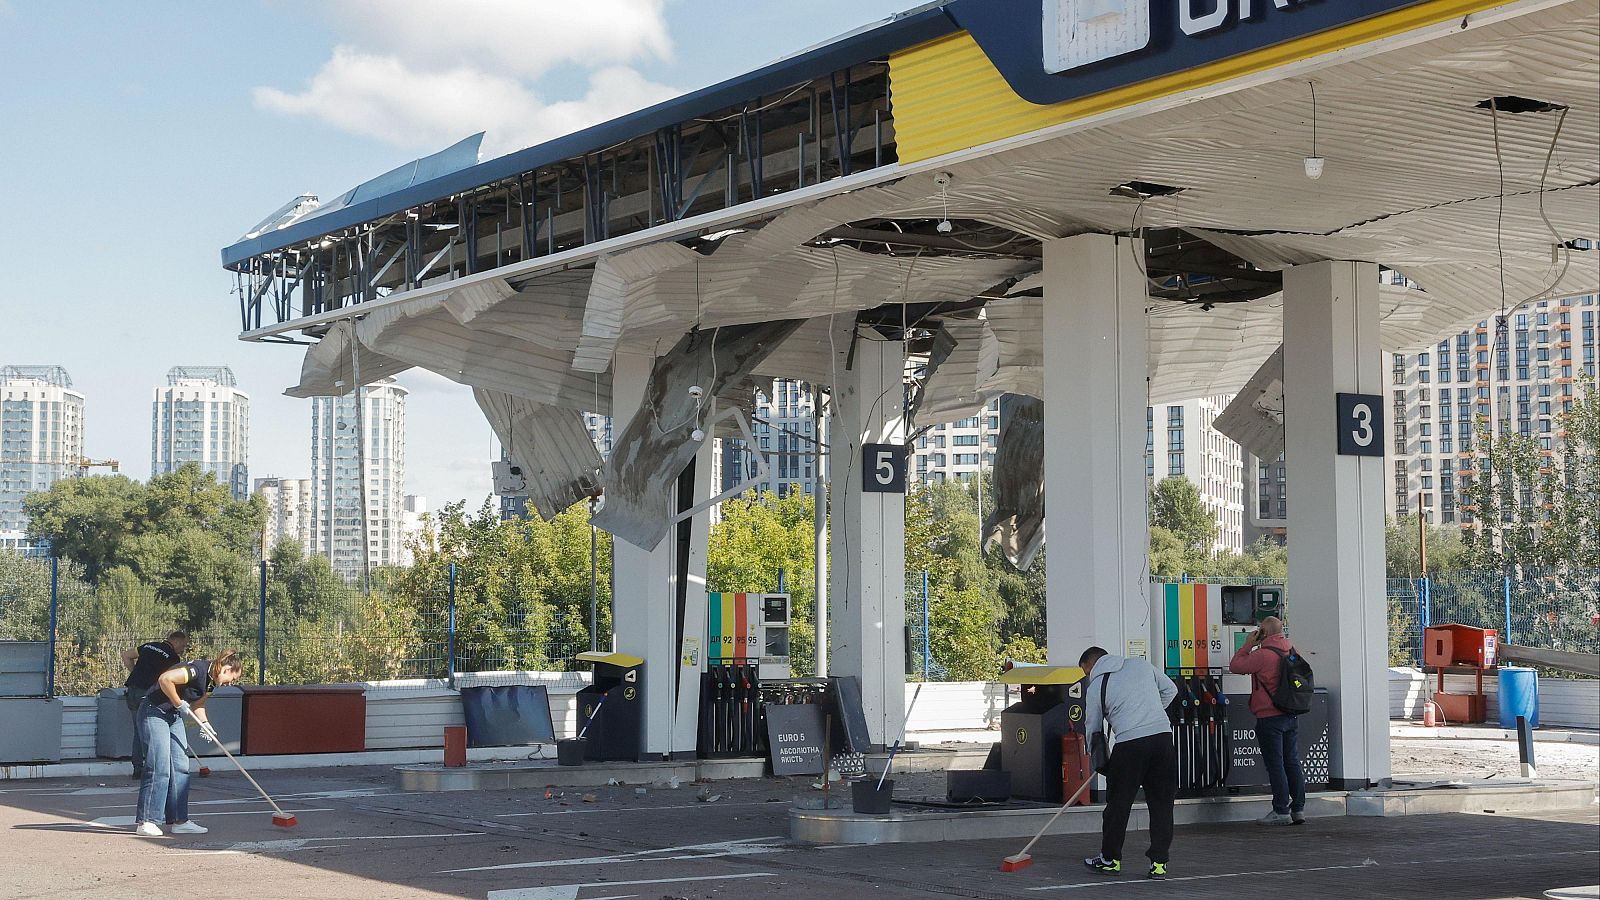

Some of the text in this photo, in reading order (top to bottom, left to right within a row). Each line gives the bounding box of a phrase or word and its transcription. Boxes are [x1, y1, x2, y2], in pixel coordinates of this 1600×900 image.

[1352, 403, 1373, 447] 3
[875, 451, 894, 485] 5
[723, 636, 732, 644] 92
[736, 636, 745, 644] 95
[748, 636, 757, 644] 95
[1168, 640, 1221, 650] ДП 92 95 95
[778, 733, 805, 742] EURO 5
[1233, 729, 1256, 740] EURO
[780, 746, 820, 755] АБСОЛЮТНА
[781, 755, 804, 763] ЯКІСТЬ
[1233, 758, 1256, 767] ЯКІСТЬ
